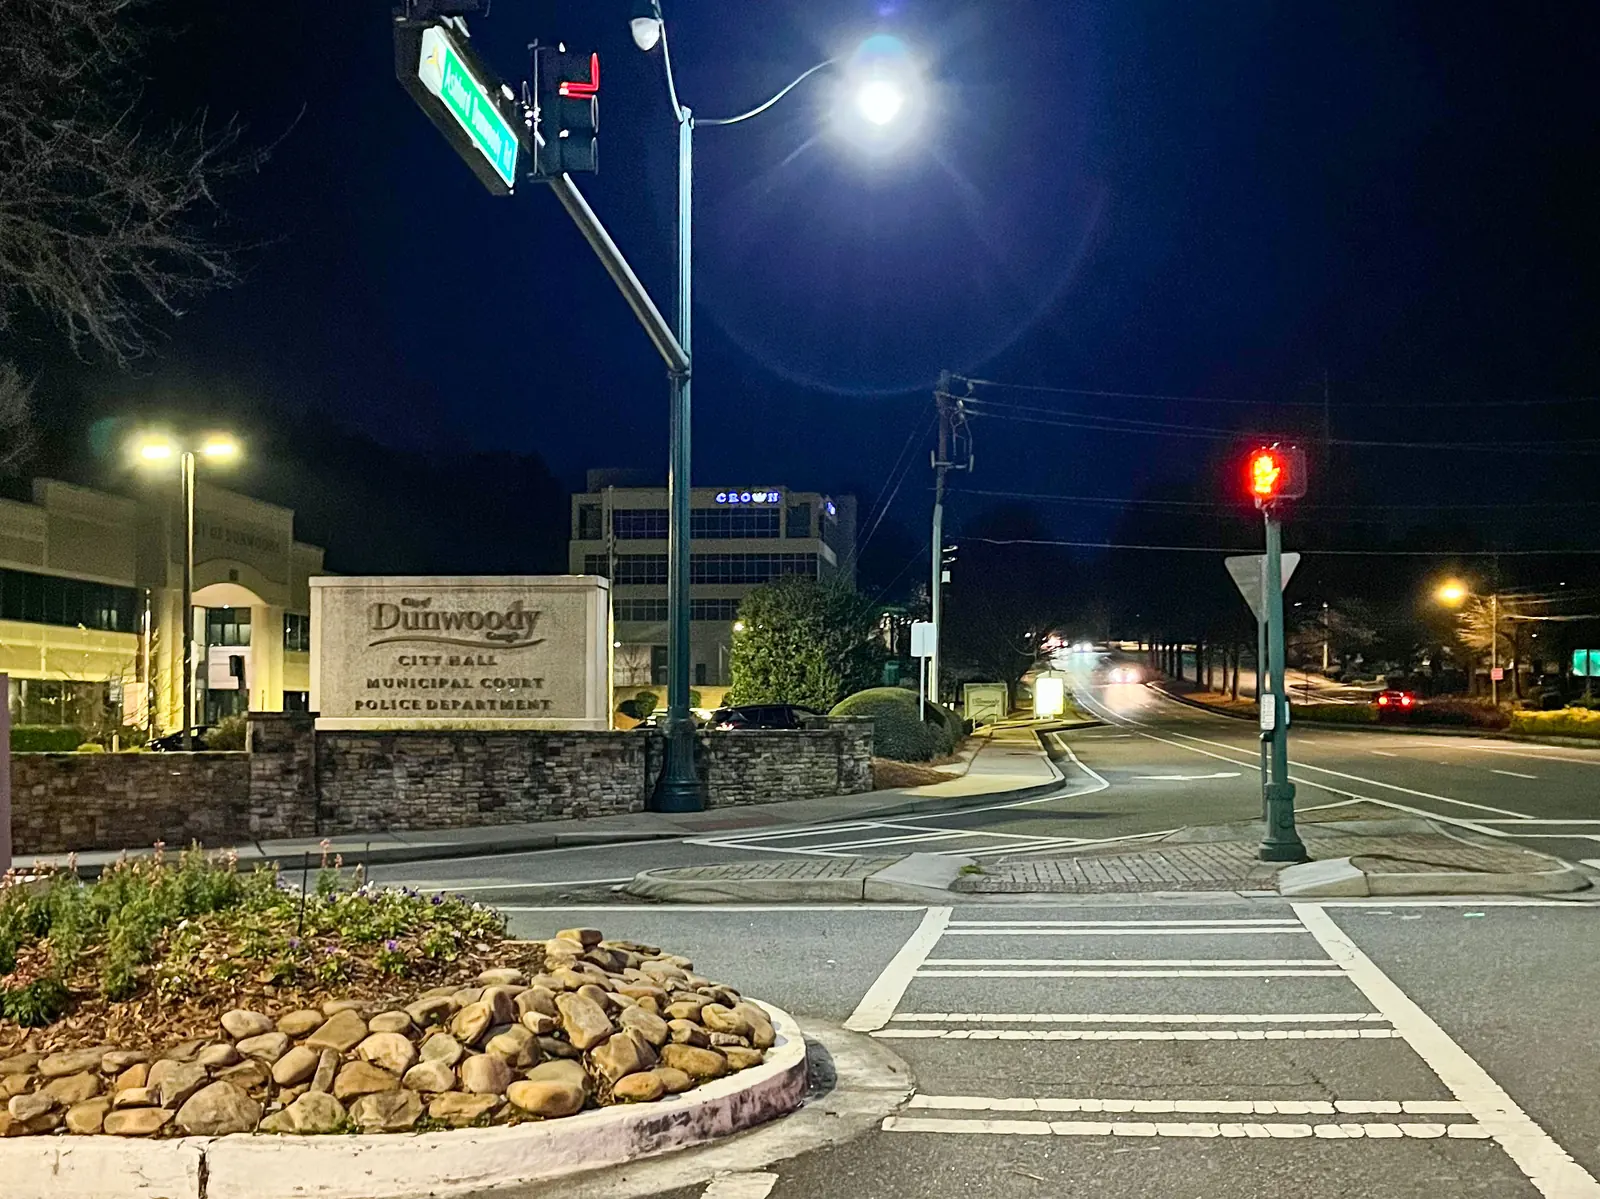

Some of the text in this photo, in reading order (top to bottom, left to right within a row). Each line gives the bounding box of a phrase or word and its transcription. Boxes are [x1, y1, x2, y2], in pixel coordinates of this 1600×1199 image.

[715, 491, 780, 503] CROWN
[368, 599, 542, 640] Dunwoody
[398, 655, 498, 666] CITY HALL
[366, 677, 544, 689] MUNICIPAL COURT
[355, 699, 552, 711] POLICE DEPARTMENT
